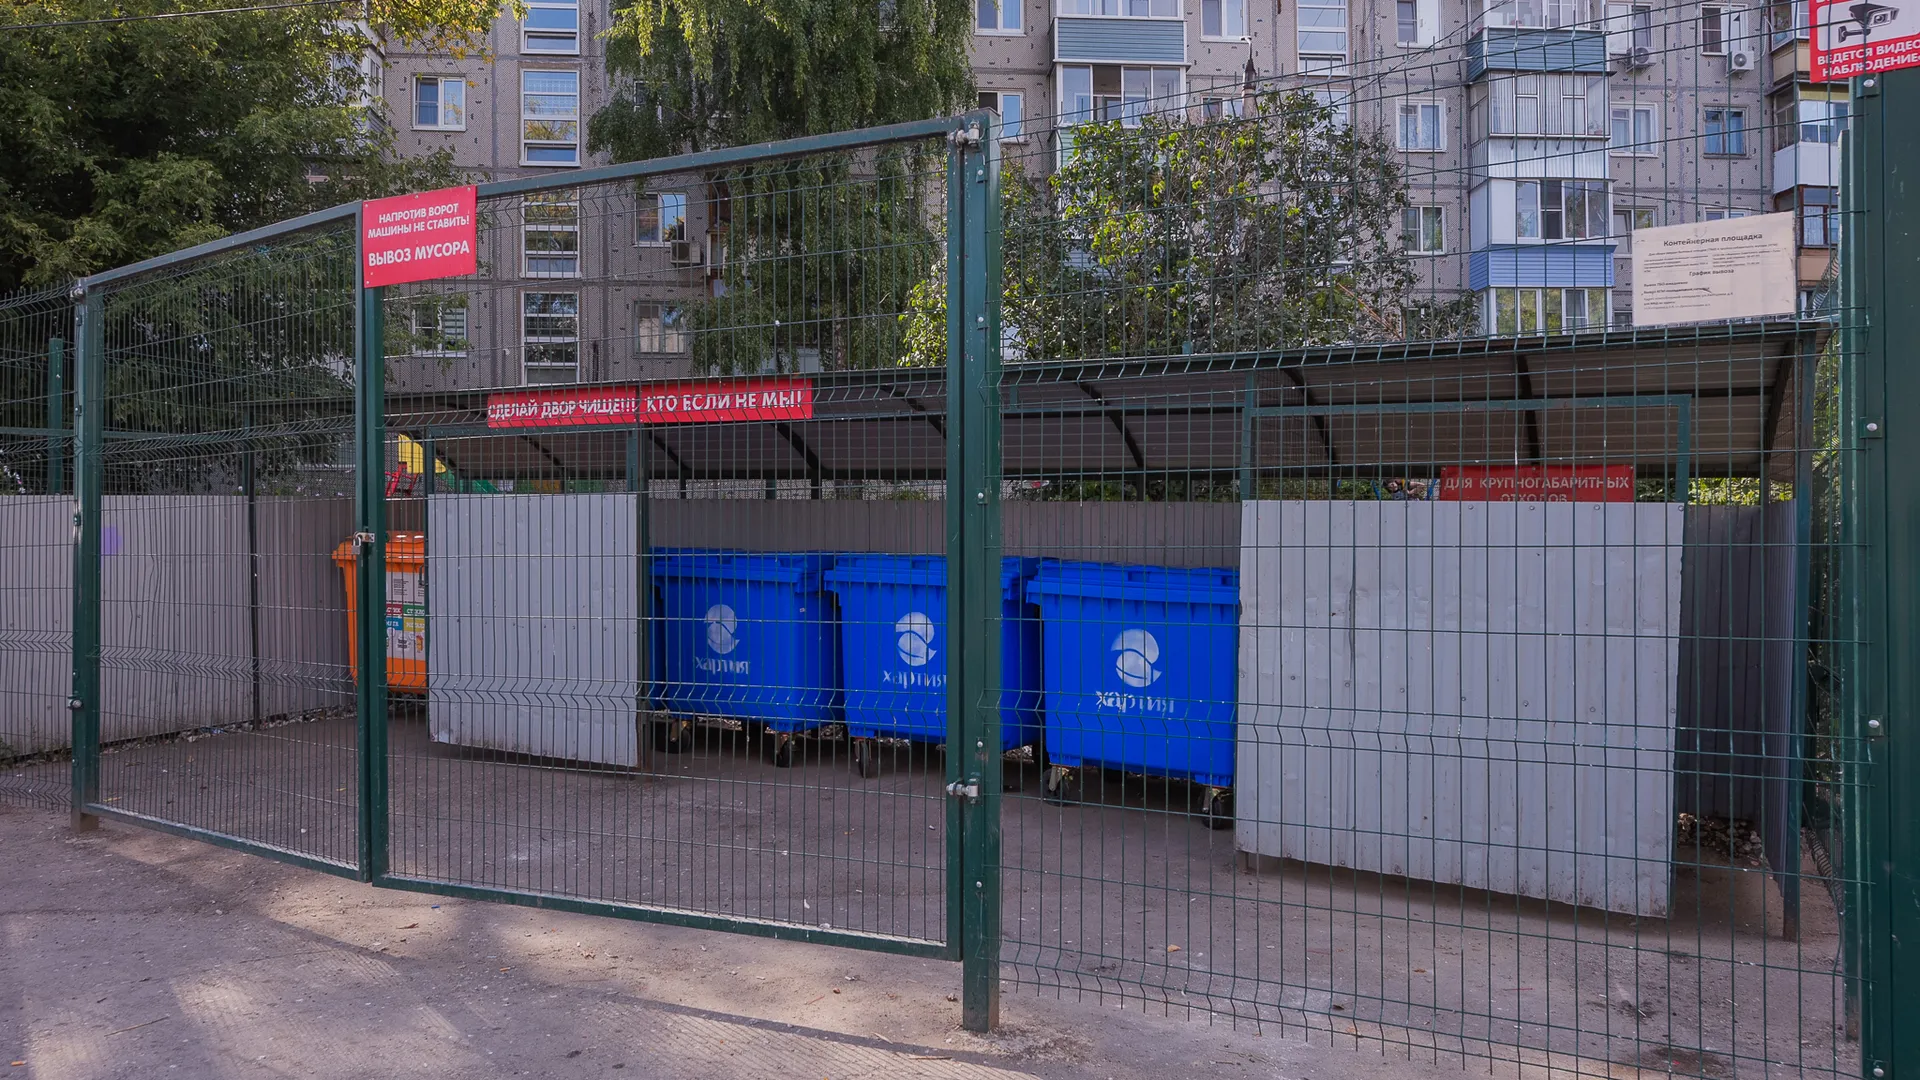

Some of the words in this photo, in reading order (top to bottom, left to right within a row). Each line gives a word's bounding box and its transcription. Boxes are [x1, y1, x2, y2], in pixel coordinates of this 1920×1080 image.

[1817, 47, 1873, 66] ВЕДЕТСЯ
[1822, 52, 1919, 77] НАБЛЮДЕНИЕ
[378, 208, 427, 224] НАПРОТИВ
[428, 203, 459, 217] ВОРОТ
[367, 223, 412, 239] МАШИНЫ
[413, 221, 425, 232] НЕ
[427, 215, 470, 230] СТАВИТЬ!
[1663, 236, 1720, 248] Контейнерная
[1721, 233, 1763, 243] площадка
[368, 248, 412, 267] ВЫВОЗ
[414, 240, 470, 261] МУСОРА
[488, 399, 538, 420] СДЕЛАЙ
[541, 401, 577, 419] ДВОР
[579, 397, 635, 415] ЧИЩЕ!!!
[645, 395, 678, 412] КТО
[682, 393, 731, 412] ЕСЛИ
[735, 393, 757, 409] НЕ
[762, 390, 801, 408] МЫ!
[1443, 477, 1473, 491] ДЛЯ
[1480, 476, 1630, 490] КРУПНОГАБАРИТНЫХ
